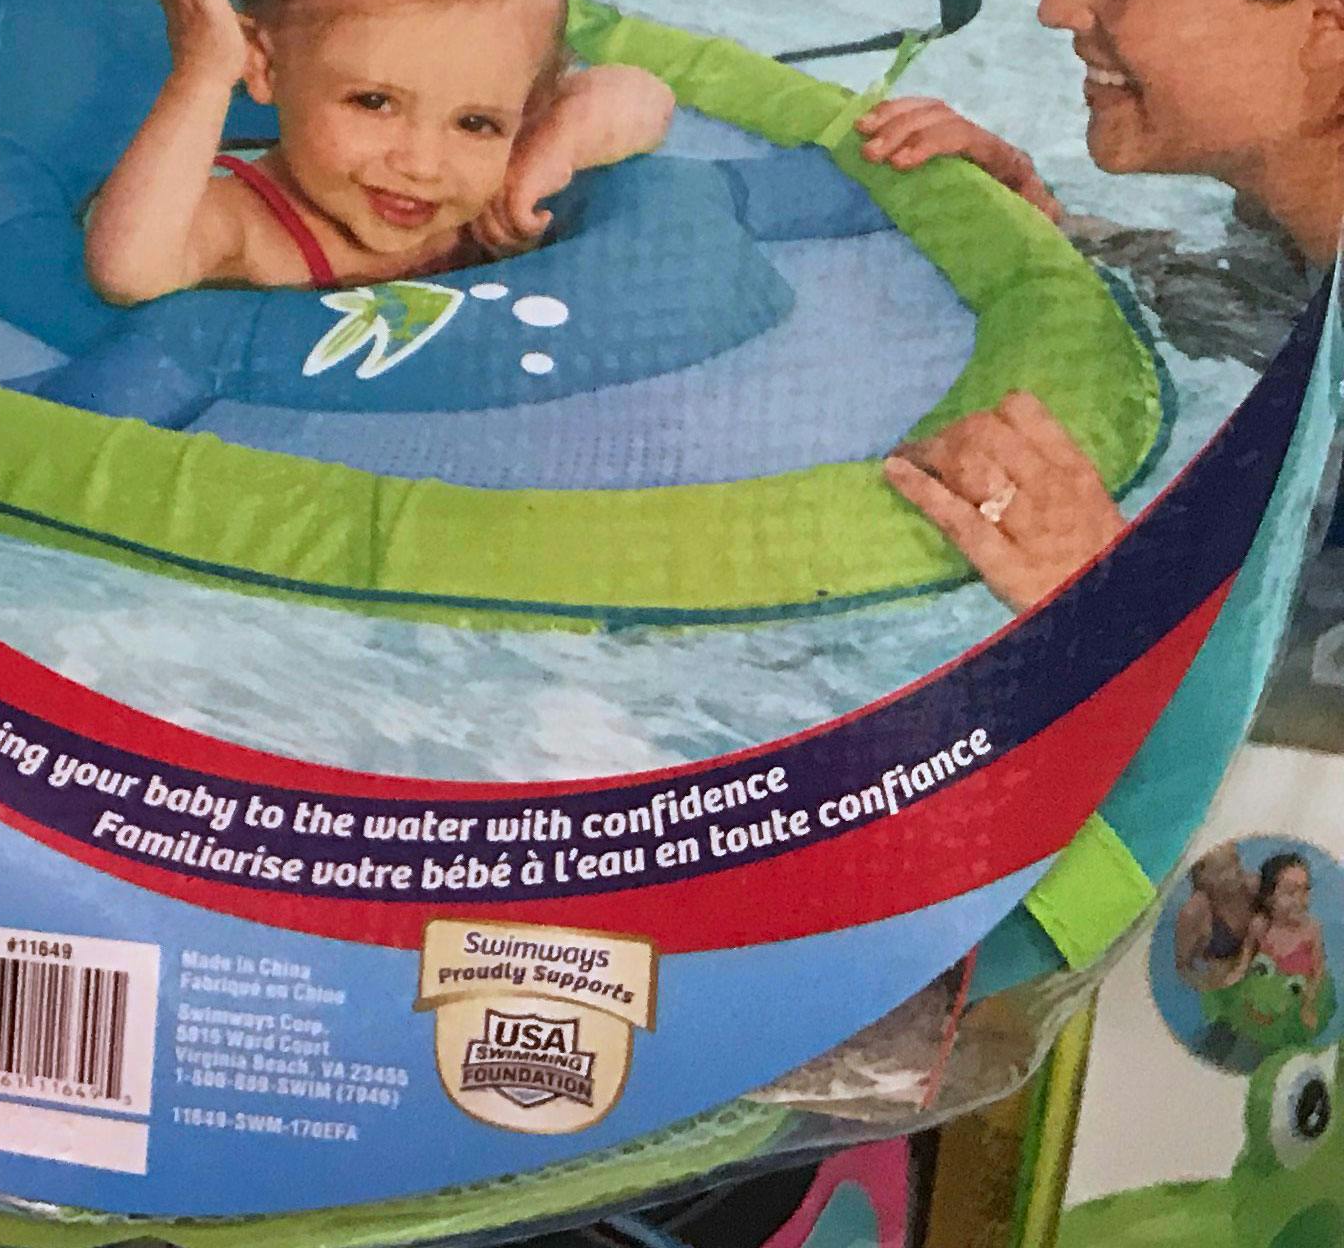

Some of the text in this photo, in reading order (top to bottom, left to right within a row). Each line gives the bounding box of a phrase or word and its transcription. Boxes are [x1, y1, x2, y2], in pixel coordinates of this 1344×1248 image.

[50, 755, 138, 800] your
[143, 775, 237, 831] baby
[245, 795, 285, 829] to
[292, 802, 352, 837] the
[364, 810, 474, 842] water
[487, 809, 572, 841] with
[581, 766, 788, 839] confidence
[92, 727, 993, 890] Familiarise votre bébé à l'eau en toute confiance
[7, 937, 73, 959] #11649
[464, 932, 610, 973] Swimways
[533, 965, 634, 1003] Supports
[494, 1022, 566, 1052] USA
[476, 1046, 582, 1071] SWIMMING
[463, 1066, 593, 1099] FOUNDATION
